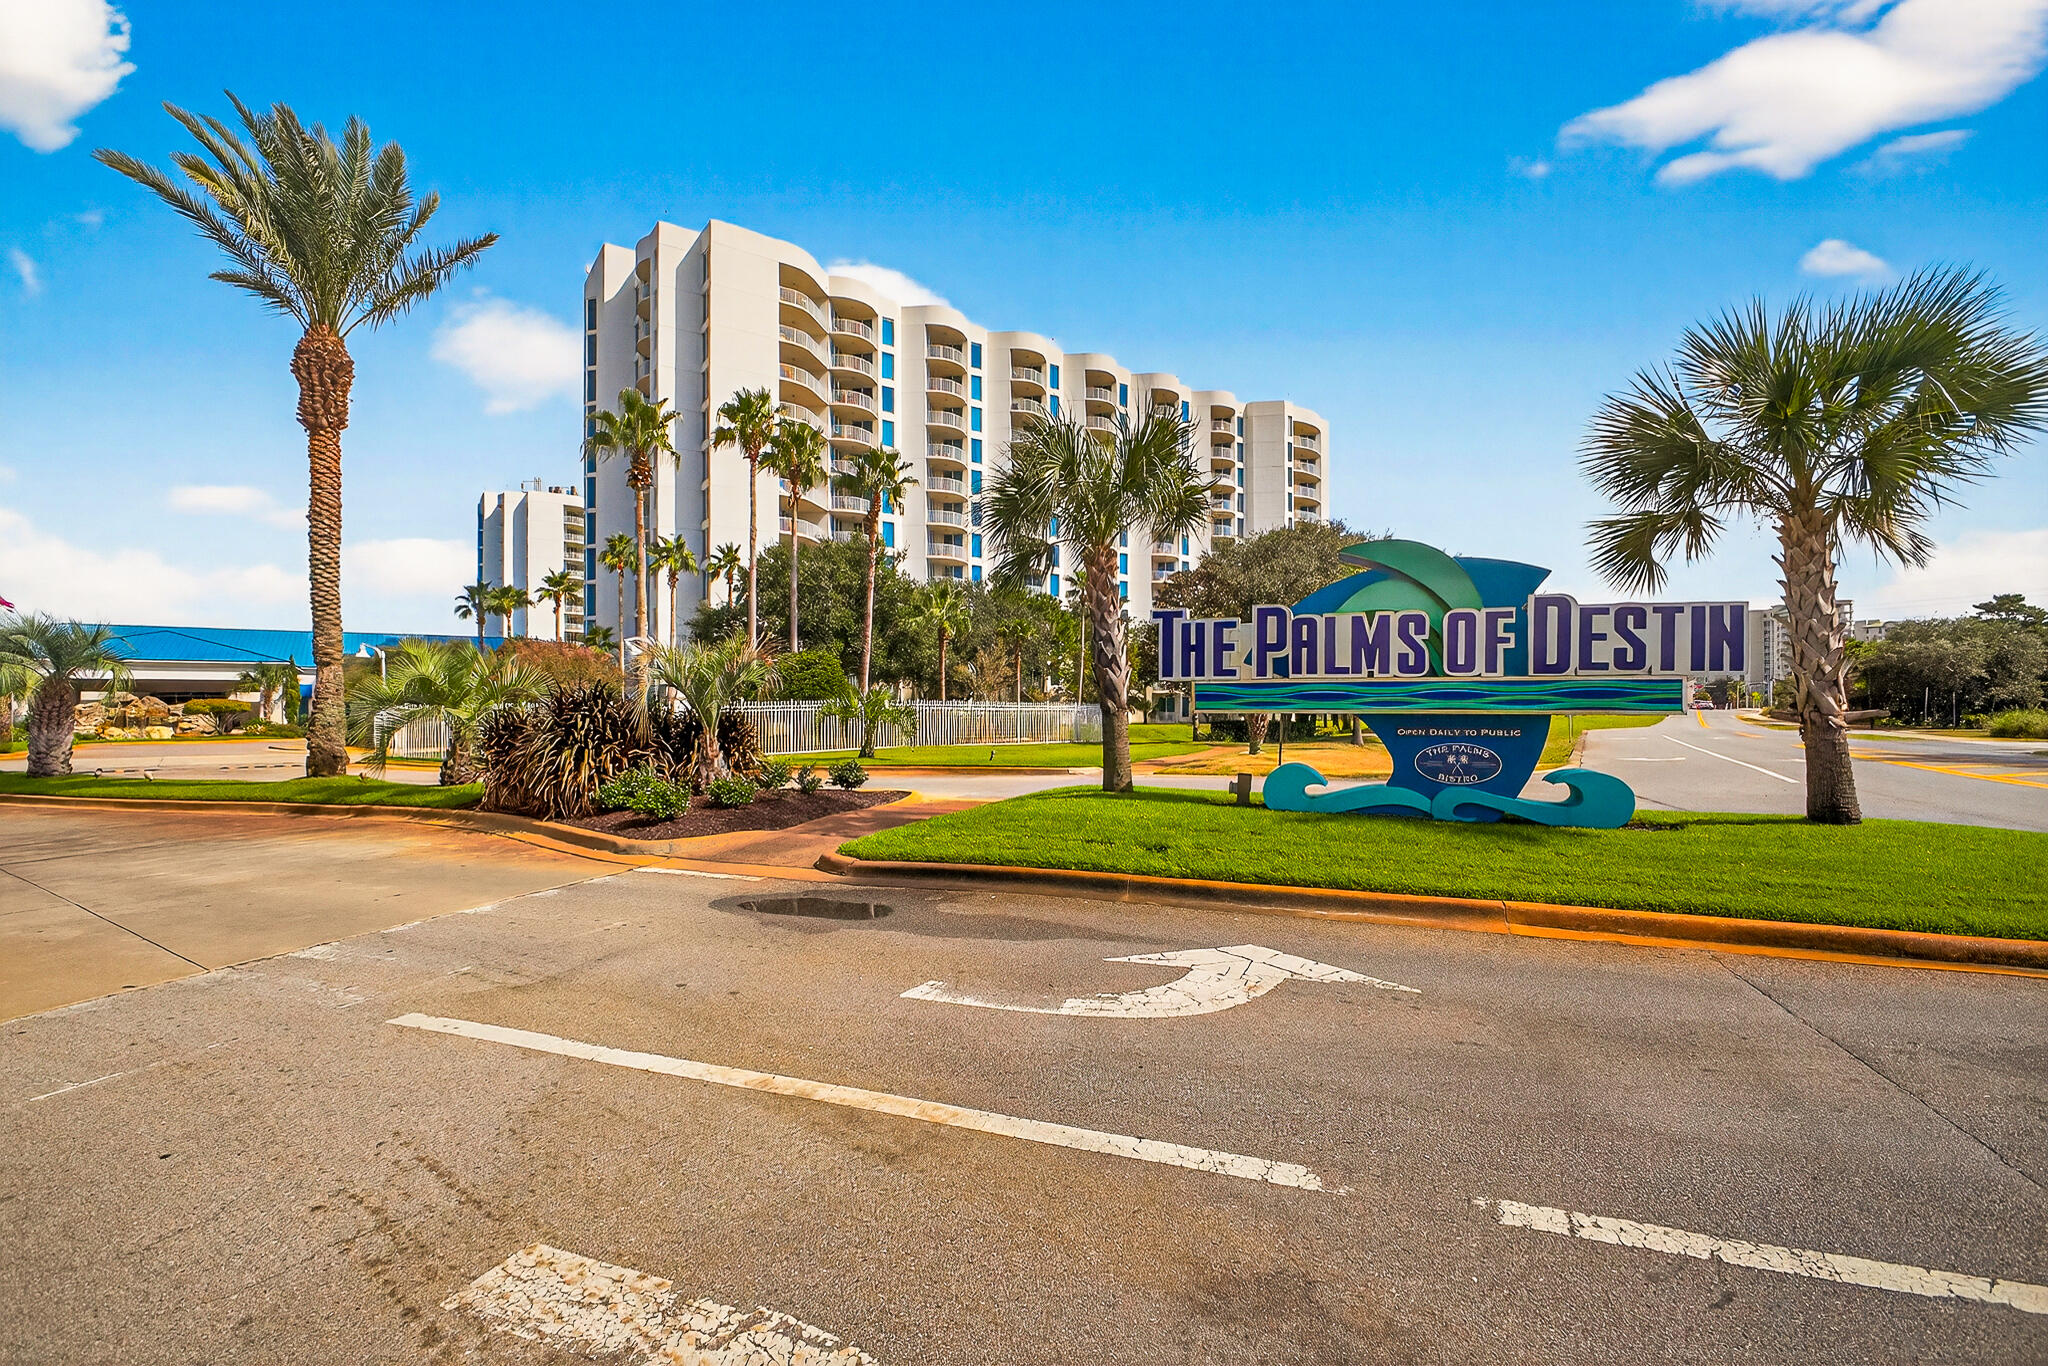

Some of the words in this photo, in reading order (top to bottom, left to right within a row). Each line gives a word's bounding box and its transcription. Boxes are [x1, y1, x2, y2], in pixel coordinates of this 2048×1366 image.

[1152, 610, 1238, 678] THE
[1254, 606, 1429, 676] PALMS
[1446, 609, 1515, 675] OF
[1533, 596, 1745, 675] DESTIN
[1429, 728, 1460, 736] DAILY
[1426, 745, 1449, 757] THE
[1452, 745, 1490, 758] PALMS
[1438, 773, 1478, 783] BISTRO
